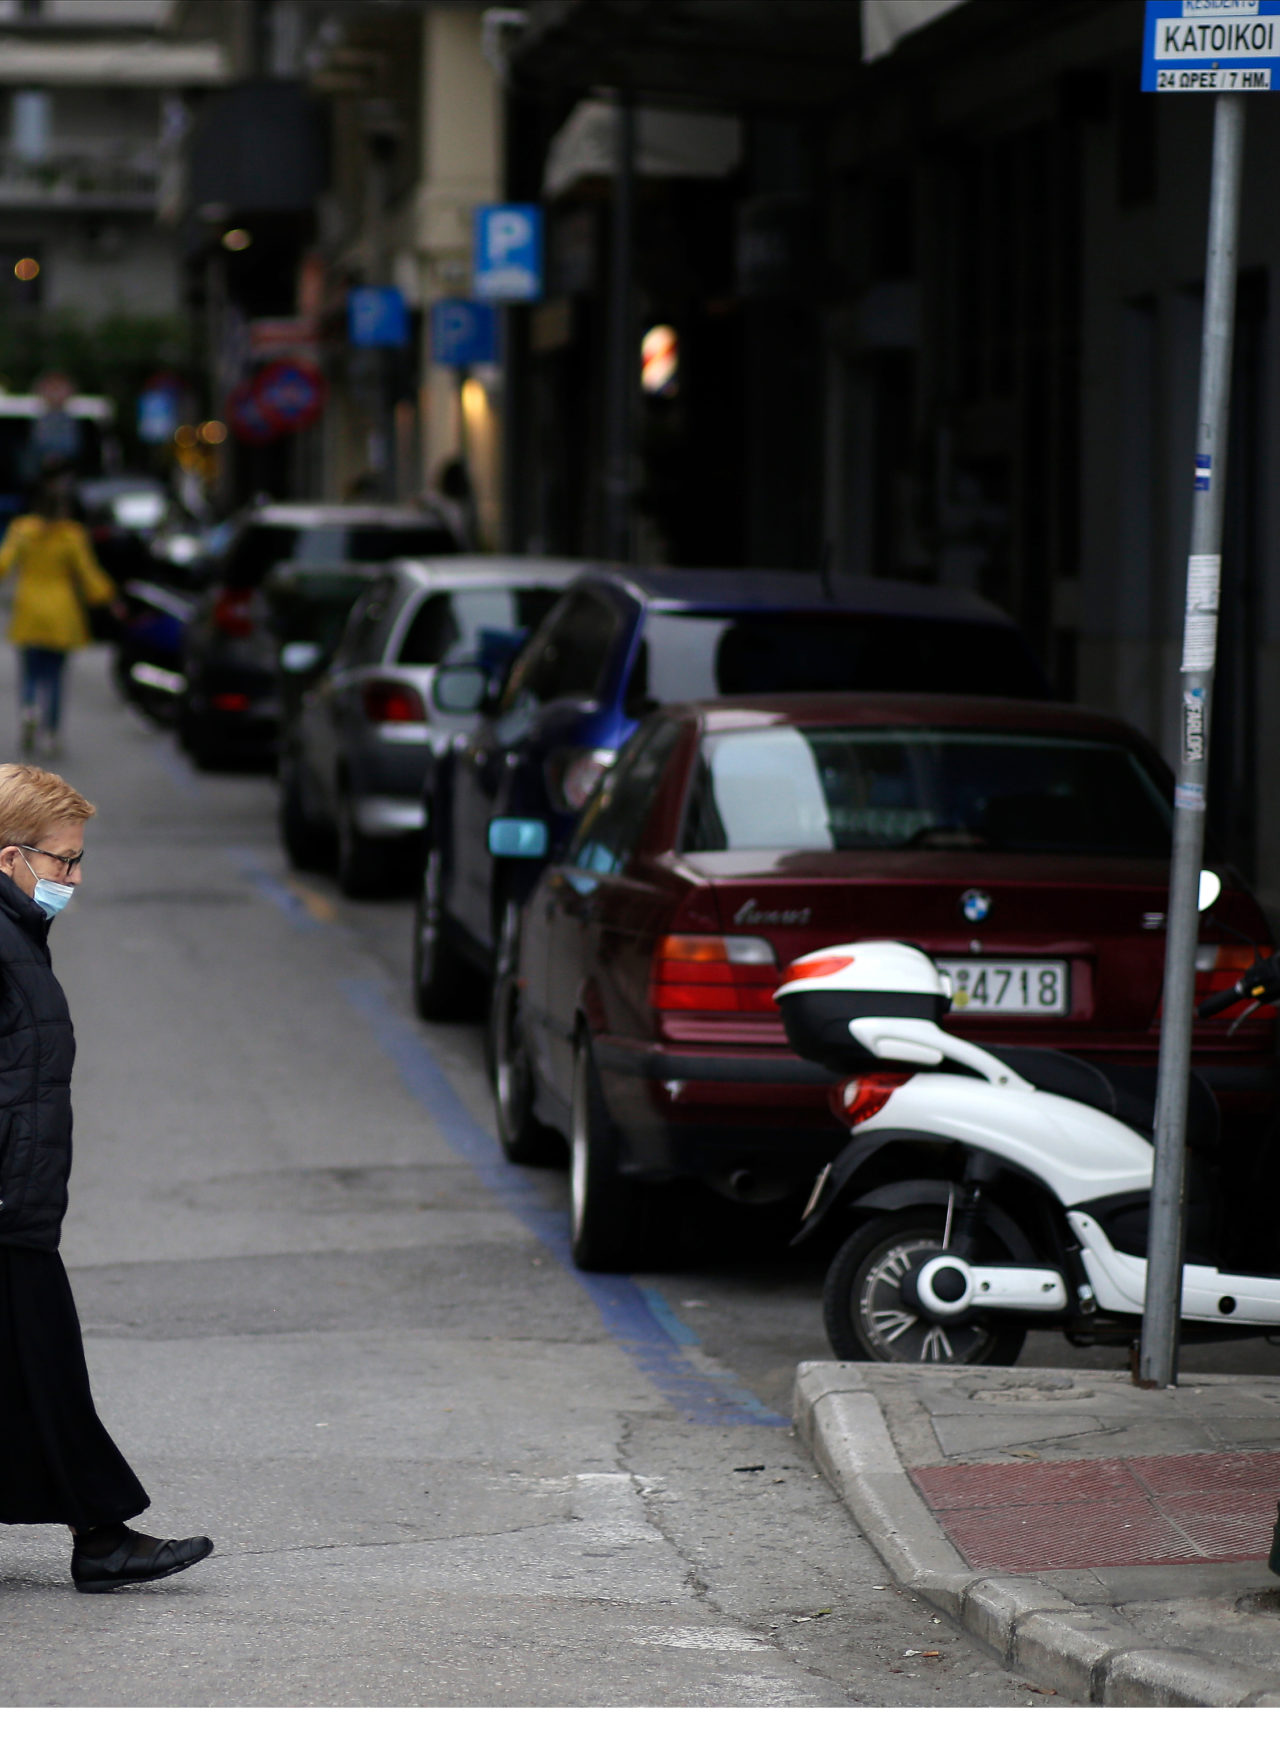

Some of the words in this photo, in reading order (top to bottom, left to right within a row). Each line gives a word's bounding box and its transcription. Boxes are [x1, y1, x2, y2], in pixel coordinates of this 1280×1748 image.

[1165, 23, 1273, 52] ΚΑΤΟΙΚΟΙ
[1159, 72, 1175, 88] 24
[1179, 72, 1217, 88] ΩΡΕΣ
[1229, 72, 1238, 88] 7
[1241, 71, 1269, 88] ΗΜ.
[486, 208, 532, 264] P
[971, 968, 1057, 1006] 4718
